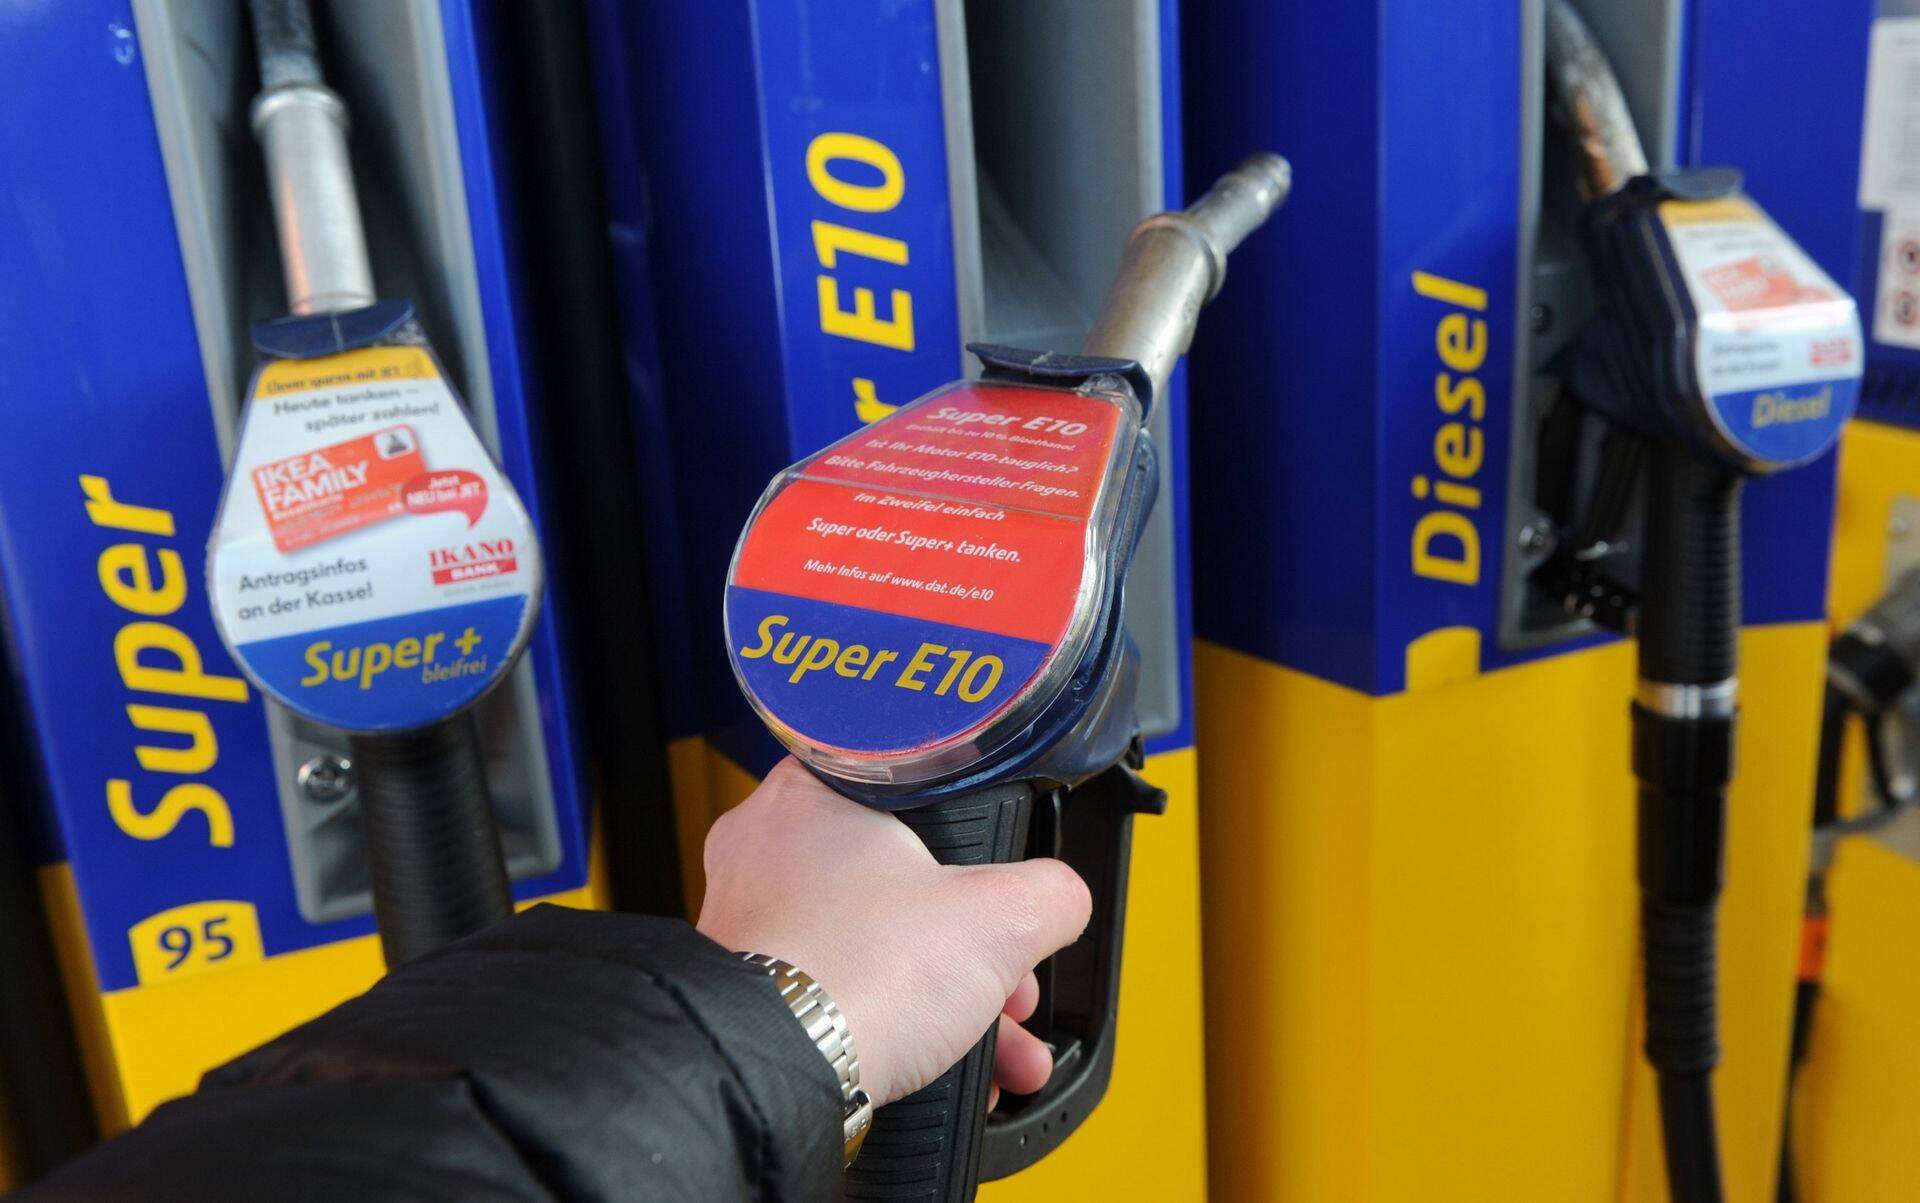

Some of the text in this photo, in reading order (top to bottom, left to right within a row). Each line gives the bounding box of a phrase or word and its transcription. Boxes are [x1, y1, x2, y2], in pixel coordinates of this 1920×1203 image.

[805, 131, 915, 352] E10
[274, 397, 331, 414] Heute
[336, 388, 402, 405] tanken
[305, 412, 366, 432] später
[926, 406, 1088, 437] Super E10
[1752, 384, 1833, 429] Diesel
[1411, 270, 1488, 586] Diesel
[258, 453, 332, 488] IKEA
[824, 455, 1080, 498] Bitte Fahrzeughersteller fragen.
[865, 438, 1080, 475] Ist Ihr Motor E10-tauglich?
[264, 460, 368, 513] FAMILY
[853, 492, 1005, 522] Im Zweifel einfach
[429, 538, 513, 567] IKANO
[806, 517, 1022, 563] Super oder Super+ tanken.
[238, 556, 369, 593] Antragsinfos
[803, 559, 994, 602] Mehr Infos auf www.dat.de/e10
[238, 581, 373, 620] an der Kasse!
[79, 474, 250, 849] Super
[301, 632, 445, 690] Super
[422, 655, 488, 684] bleifrei
[740, 614, 1004, 703] Super E10
[158, 918, 235, 970] 95
